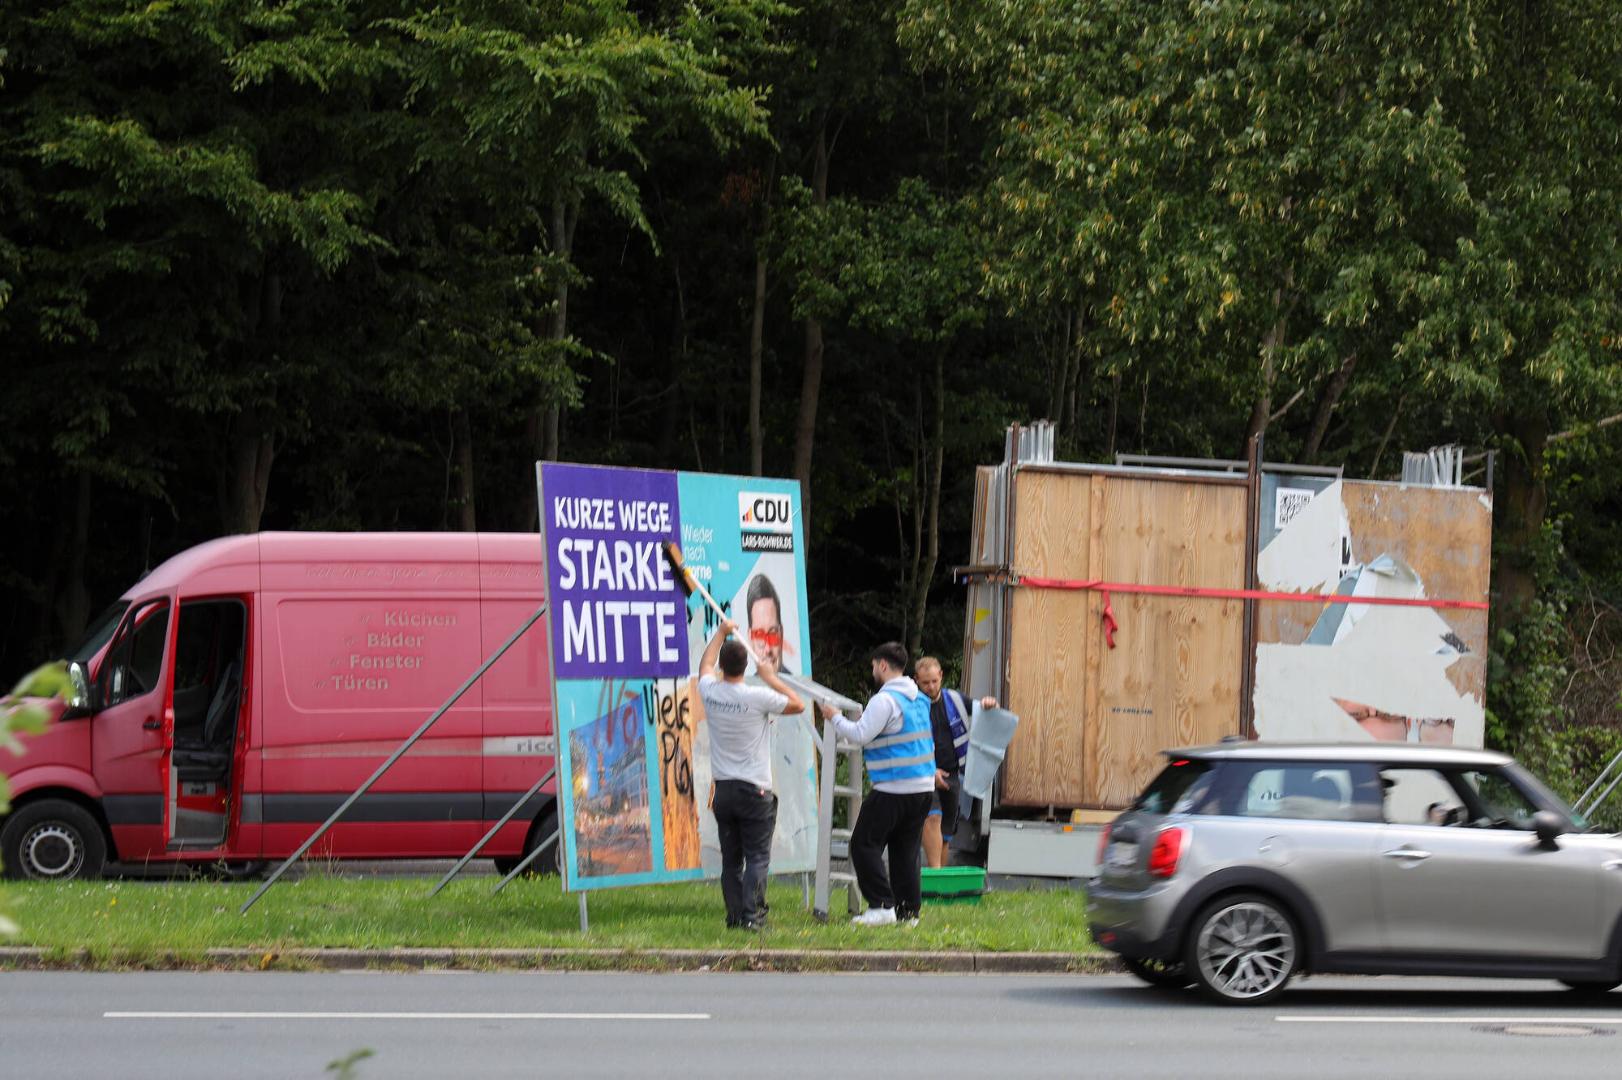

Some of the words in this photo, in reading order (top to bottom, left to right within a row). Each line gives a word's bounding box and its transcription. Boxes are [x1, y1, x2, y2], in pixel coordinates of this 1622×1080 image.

[554, 496, 615, 530] KURZE
[618, 499, 672, 533] WEGE
[753, 498, 790, 523] CDU
[682, 524, 714, 543] Wieder
[683, 545, 706, 561] nach
[557, 538, 675, 592] STARKE
[683, 565, 712, 580] orne
[384, 611, 458, 626] Küchen
[562, 599, 680, 664] MITTE
[367, 632, 425, 648] Bäder
[349, 654, 424, 669] Fenster
[331, 674, 389, 690] Türen
